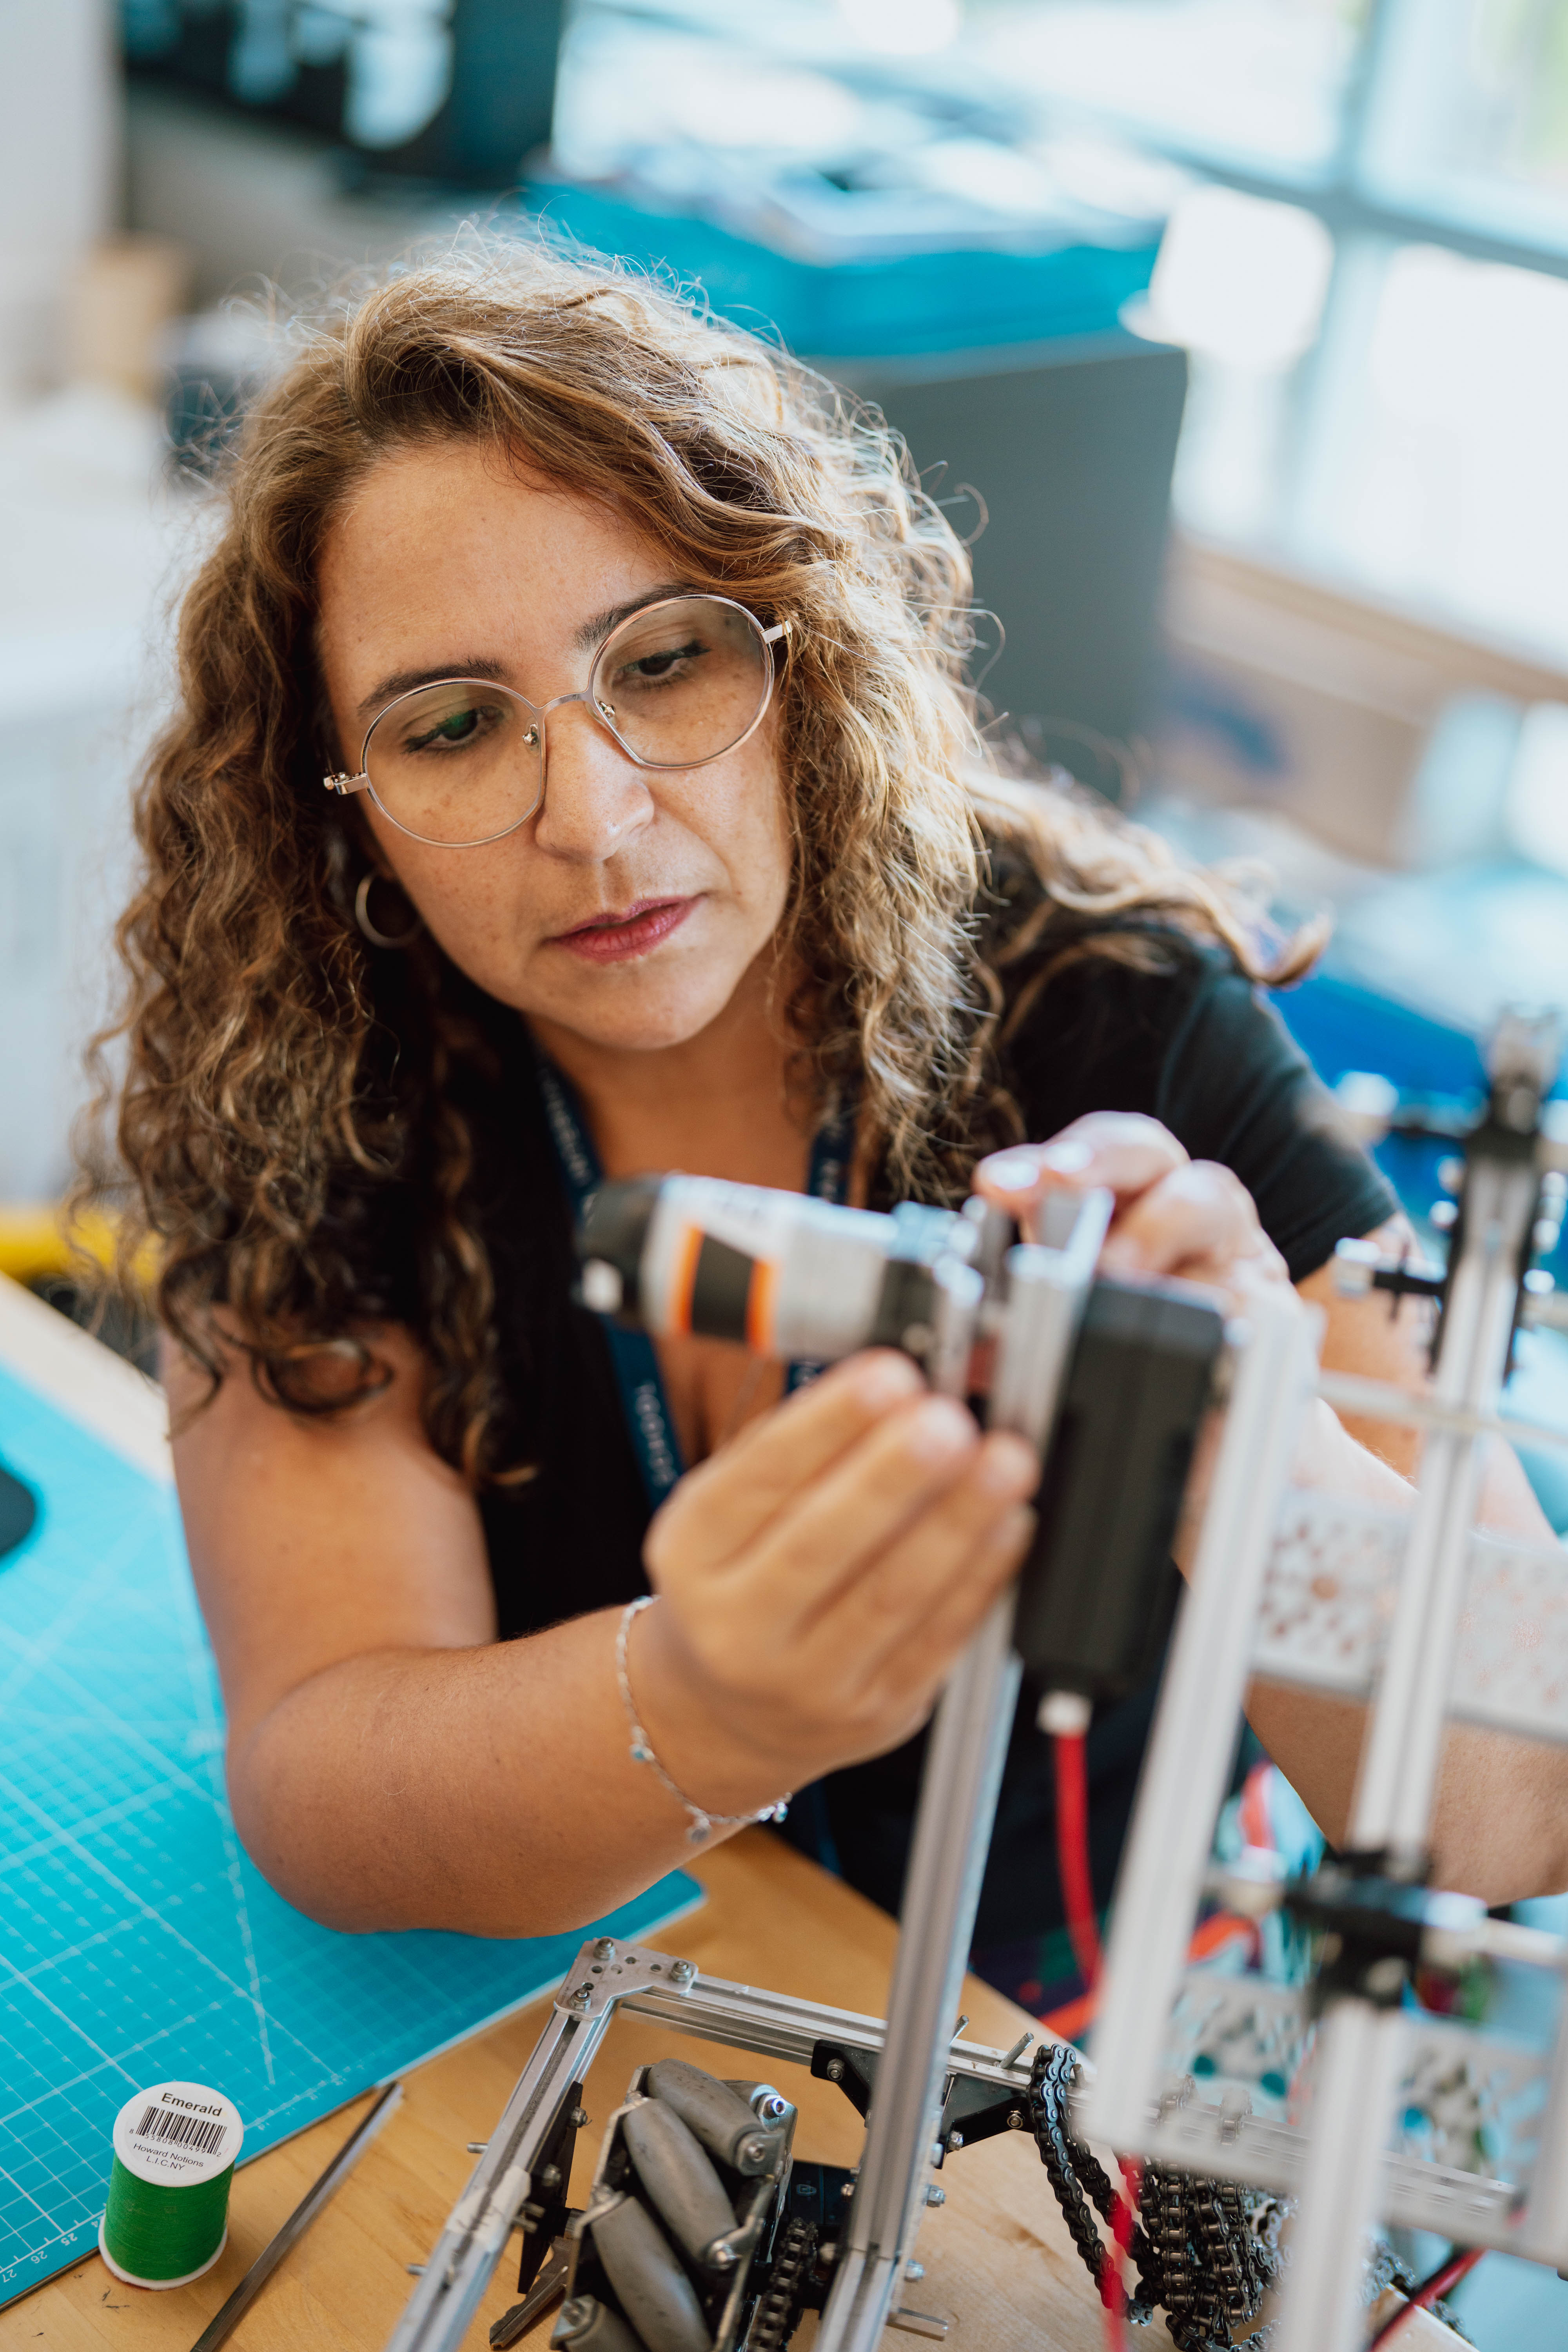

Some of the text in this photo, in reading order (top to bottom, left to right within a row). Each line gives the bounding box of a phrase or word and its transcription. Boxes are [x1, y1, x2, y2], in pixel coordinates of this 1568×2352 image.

[161, 2092, 222, 2116] Emerald
[145, 2134, 172, 2145] 55808
[178, 2142, 206, 2153] 00499
[133, 2143, 204, 2167] Howard Notions
[146, 2156, 185, 2170] L.I.C.NY
[61, 2233, 78, 2245] 25
[31, 2250, 47, 2263] 26
[2, 2269, 17, 2283] 27
